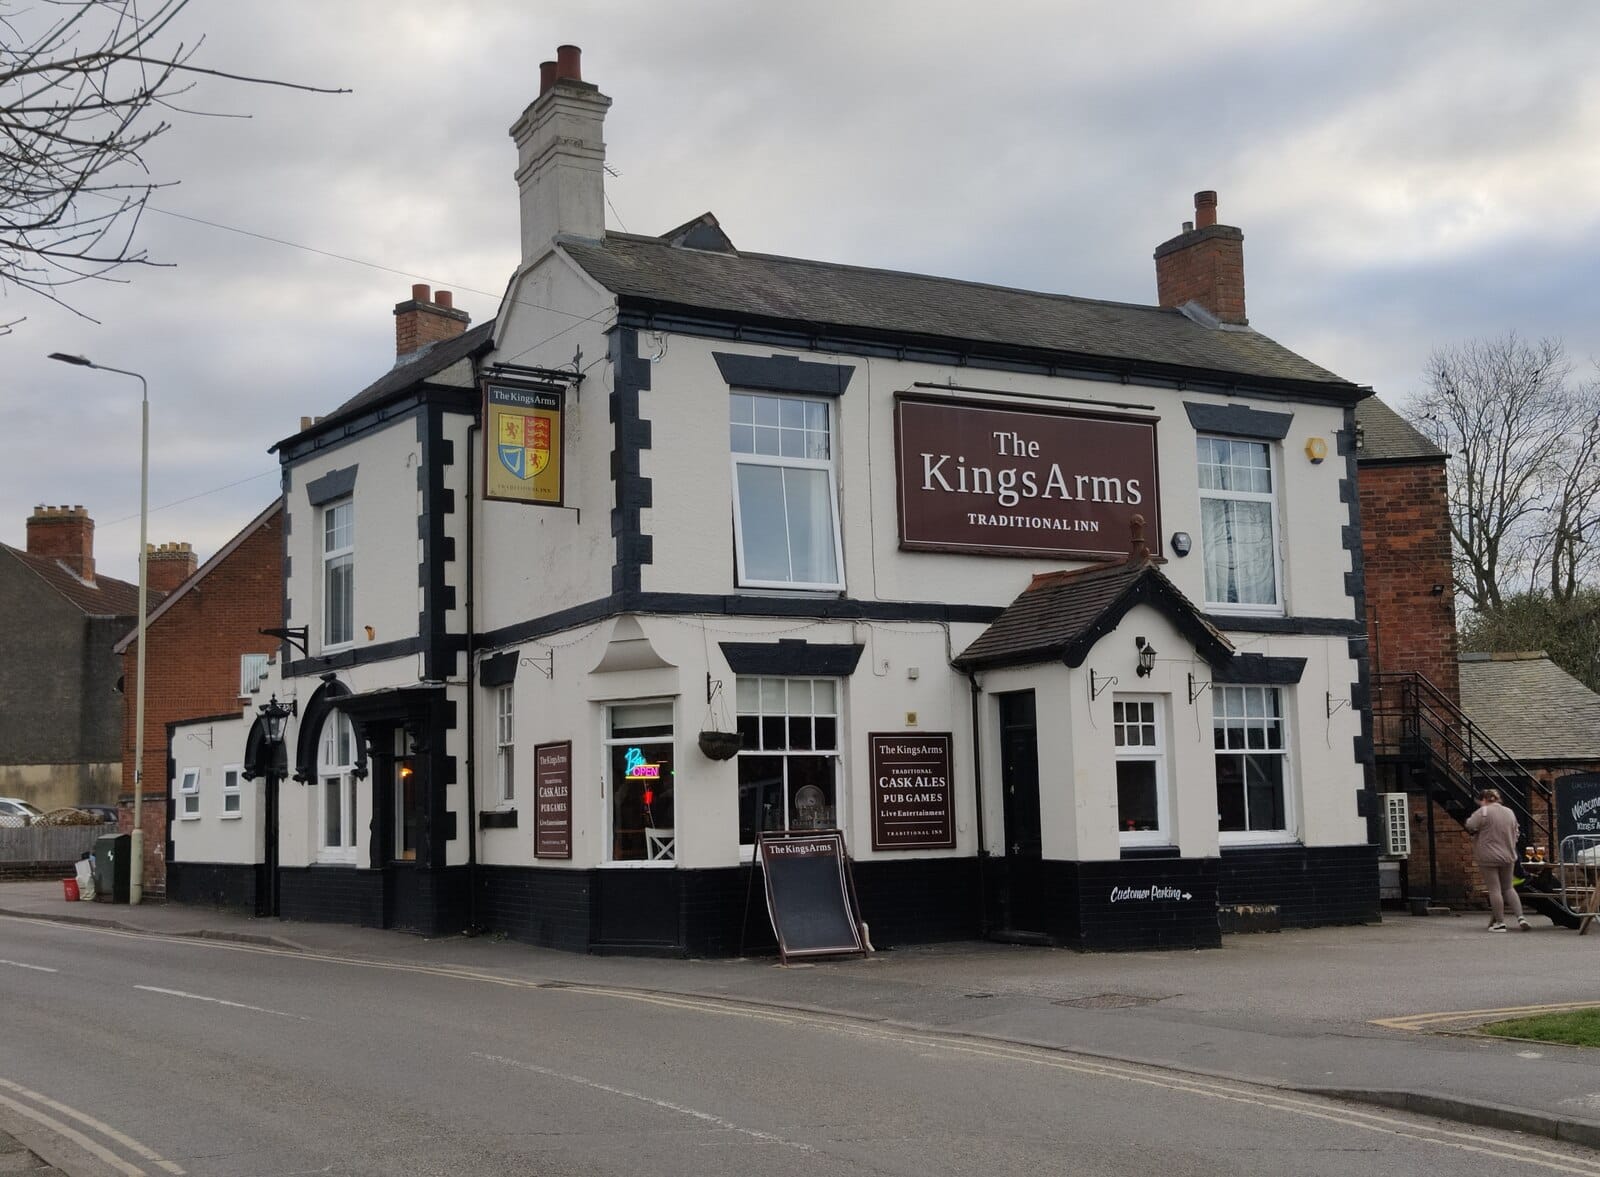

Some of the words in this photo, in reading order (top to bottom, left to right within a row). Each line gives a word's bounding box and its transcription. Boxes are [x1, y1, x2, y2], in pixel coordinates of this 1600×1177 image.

[493, 390, 509, 400] The
[510, 392, 534, 404] Kings
[534, 395, 556, 406] Arms
[993, 431, 1040, 458] The
[920, 453, 1038, 507] Kings
[1041, 463, 1142, 505] Arms
[968, 513, 1071, 531] TRADITIONAL
[1074, 519, 1099, 532] INN
[879, 745, 896, 754] The
[896, 745, 920, 756] Kings
[921, 745, 943, 754] Arms
[632, 767, 658, 777] OPEN
[880, 776, 912, 788] CASK
[914, 776, 946, 788] ALES
[540, 786, 554, 797] CASK
[554, 786, 568, 796] ALES
[883, 793, 904, 803] PUB
[905, 793, 943, 802] GAMES
[881, 809, 897, 817] Live
[897, 809, 945, 817] Entertainment
[1571, 796, 1600, 821] Welcom
[769, 845, 785, 854] The
[785, 844, 809, 855] Kings
[810, 843, 832, 852] Arms
[1110, 886, 1150, 903] Customer
[1151, 884, 1182, 901] Parking
